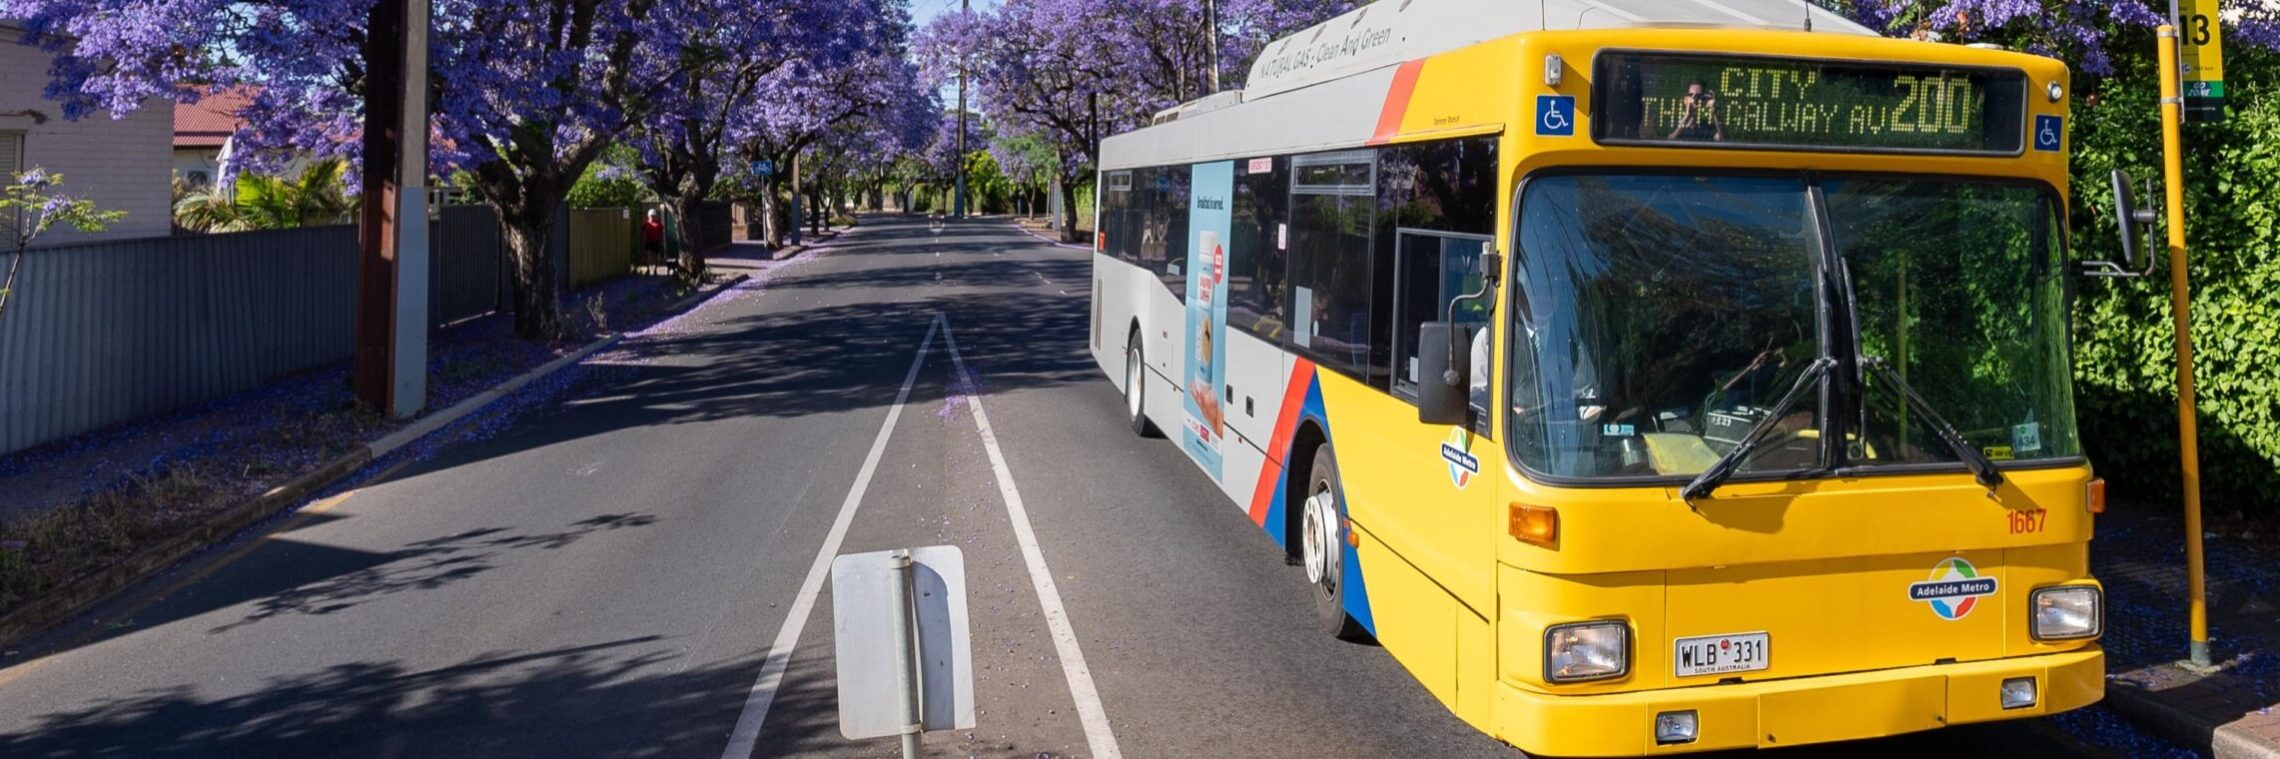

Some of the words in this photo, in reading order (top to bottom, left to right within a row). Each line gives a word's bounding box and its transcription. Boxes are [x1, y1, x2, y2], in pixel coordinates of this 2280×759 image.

[2179, 14, 2211, 46] 13
[1260, 56, 1291, 79] NATURAL
[1293, 48, 1312, 70] GAS
[1316, 43, 1340, 63] Clean
[1340, 32, 1361, 54] And
[1361, 27, 1391, 51] Green
[1721, 67, 1816, 99] CITY
[2187, 88, 2212, 97] ZONE
[2193, 81, 2207, 89] GO
[1725, 101, 1838, 133] GALWAY
[1849, 105, 1886, 135] AV
[1891, 75, 1972, 134] 200
[2018, 435, 2036, 447] 434
[2007, 508, 2047, 534] 1667
[1917, 583, 1959, 597] Adelaide
[1961, 581, 1990, 594] Metro
[1681, 644, 1716, 668] WLB
[1733, 640, 1761, 662] 331
[1695, 666, 1715, 674] SOUTH
[1717, 664, 1751, 672] AUSTRALIA
